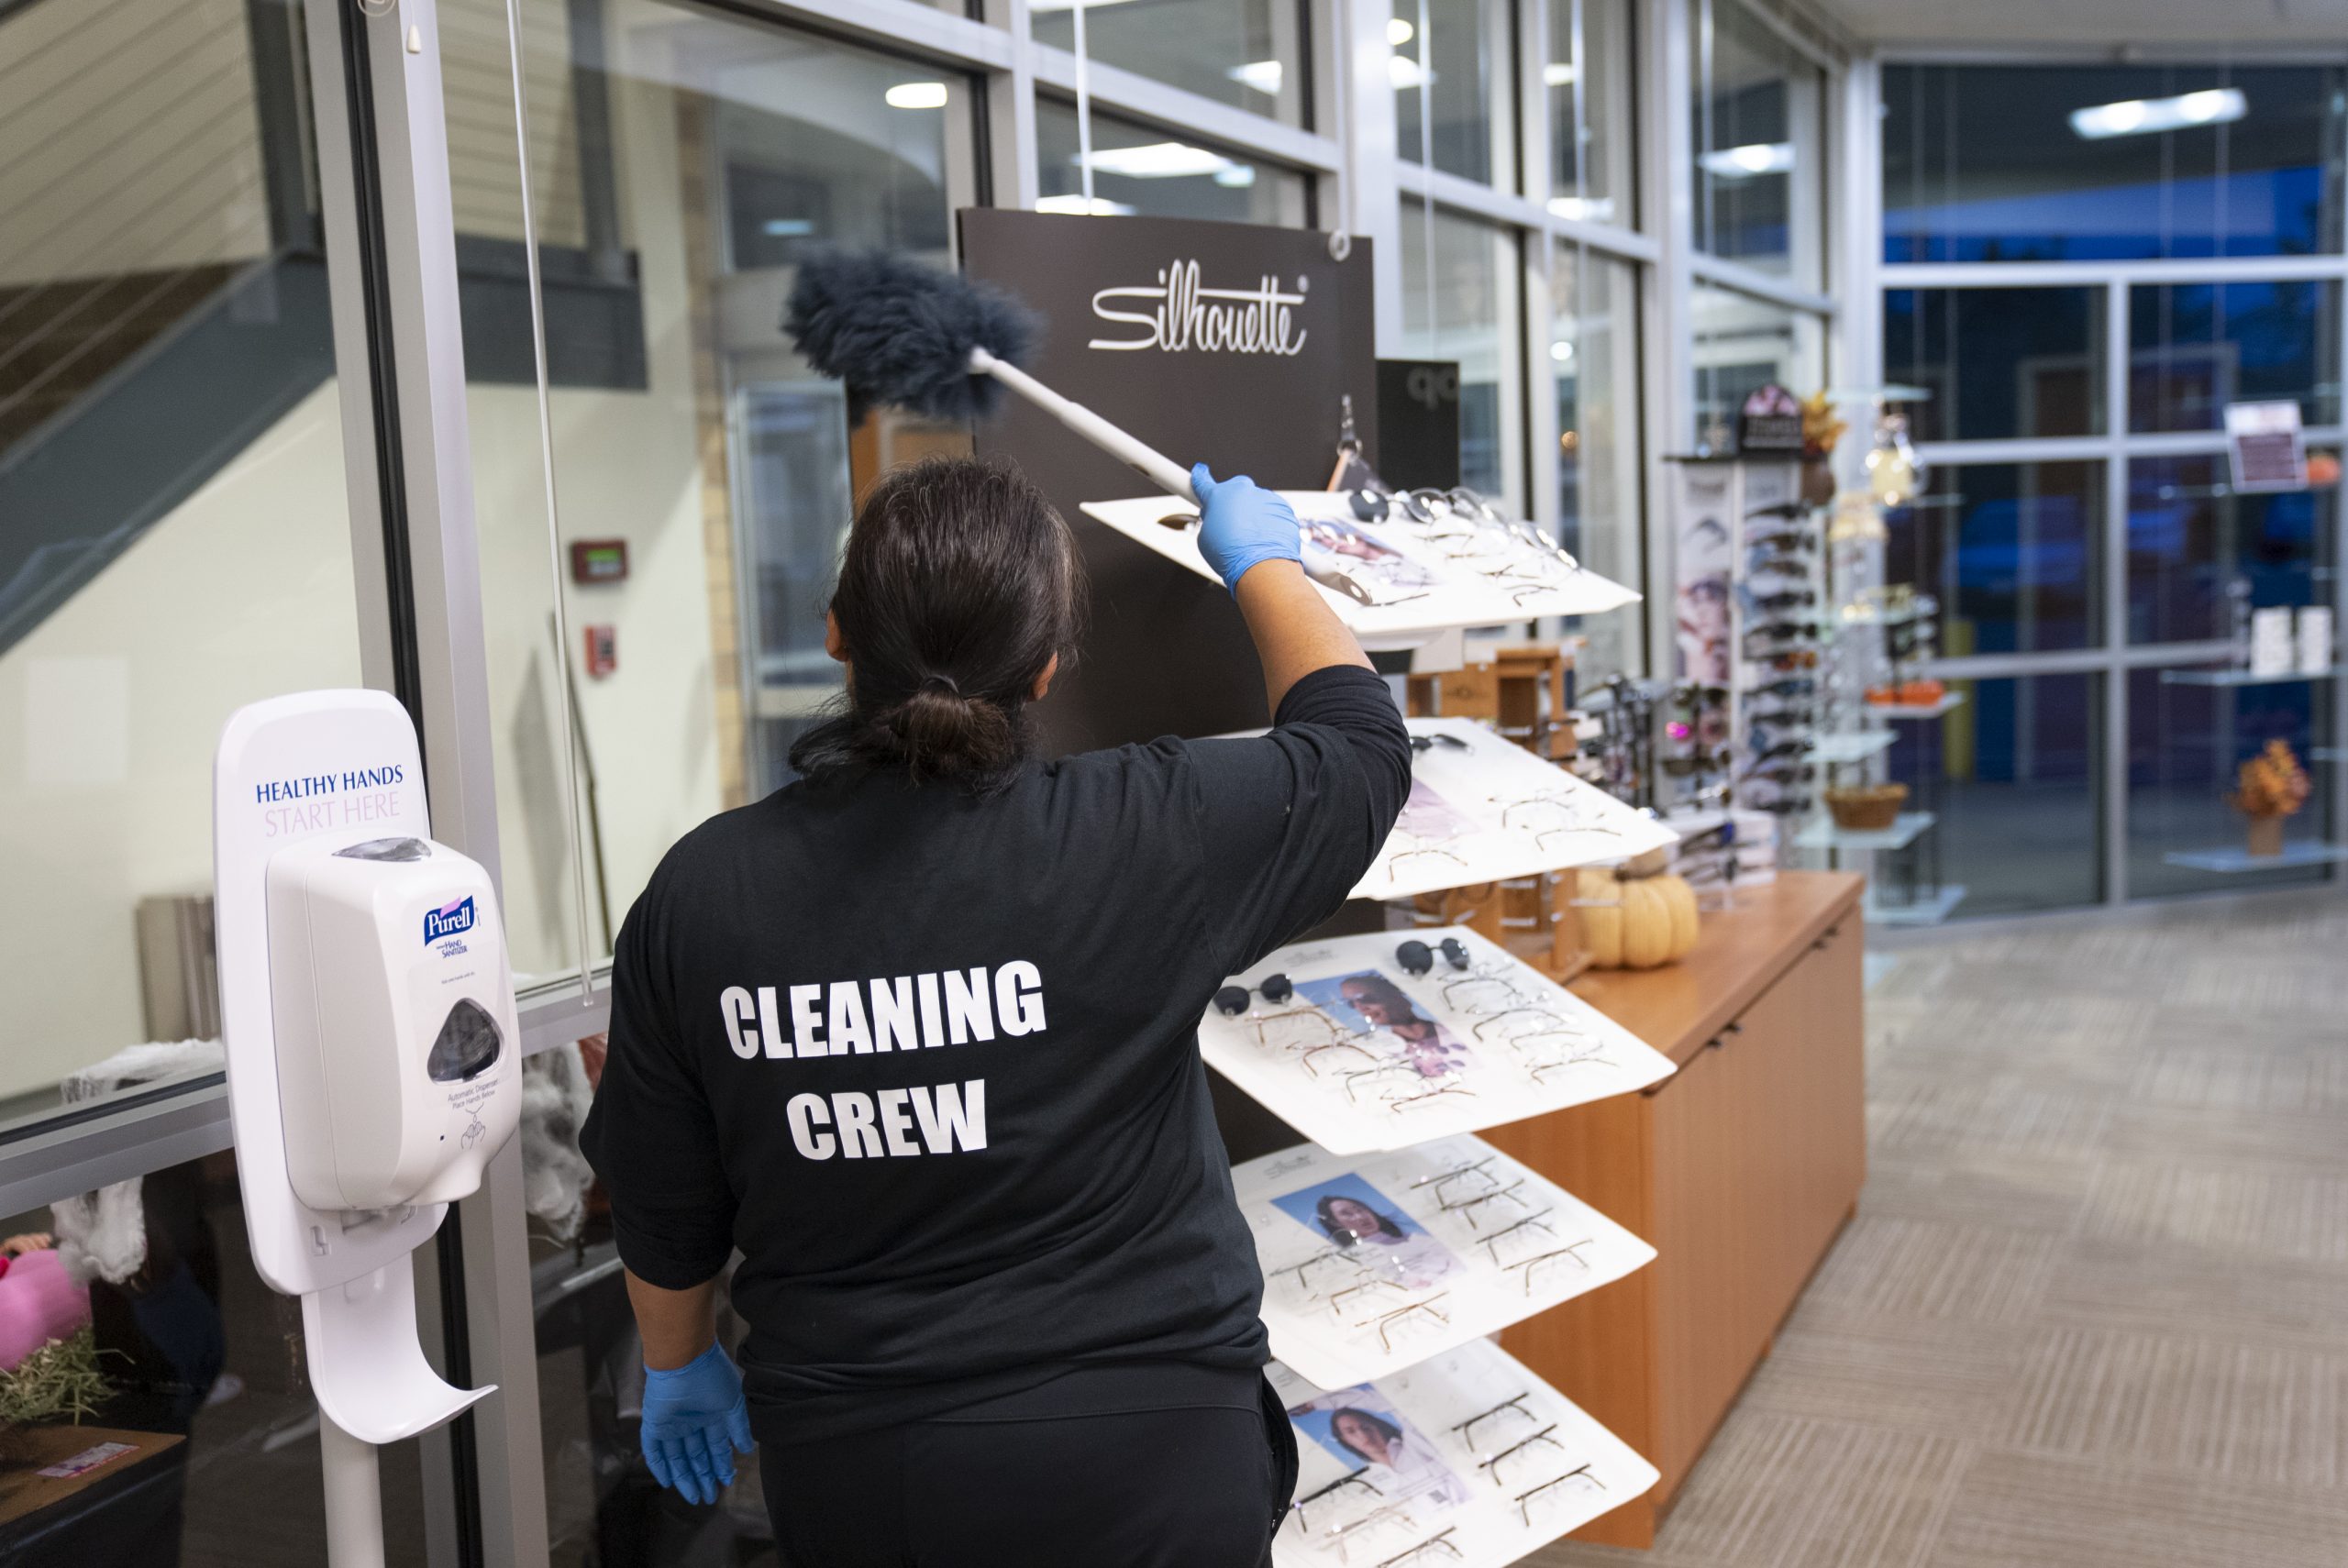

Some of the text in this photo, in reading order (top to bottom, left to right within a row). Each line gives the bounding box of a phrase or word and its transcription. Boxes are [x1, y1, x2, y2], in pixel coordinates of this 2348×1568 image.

[1088, 259, 1308, 356] Silhouette
[256, 764, 404, 803] HEALTHY HANDS
[265, 791, 400, 837] START HERE
[427, 906, 471, 936] Purell
[720, 960, 1047, 1059] CLEANING
[448, 1088, 474, 1101] Automatic
[452, 1100, 465, 1110] Place
[466, 1095, 481, 1105] Hands
[786, 1078, 987, 1160] CREW
